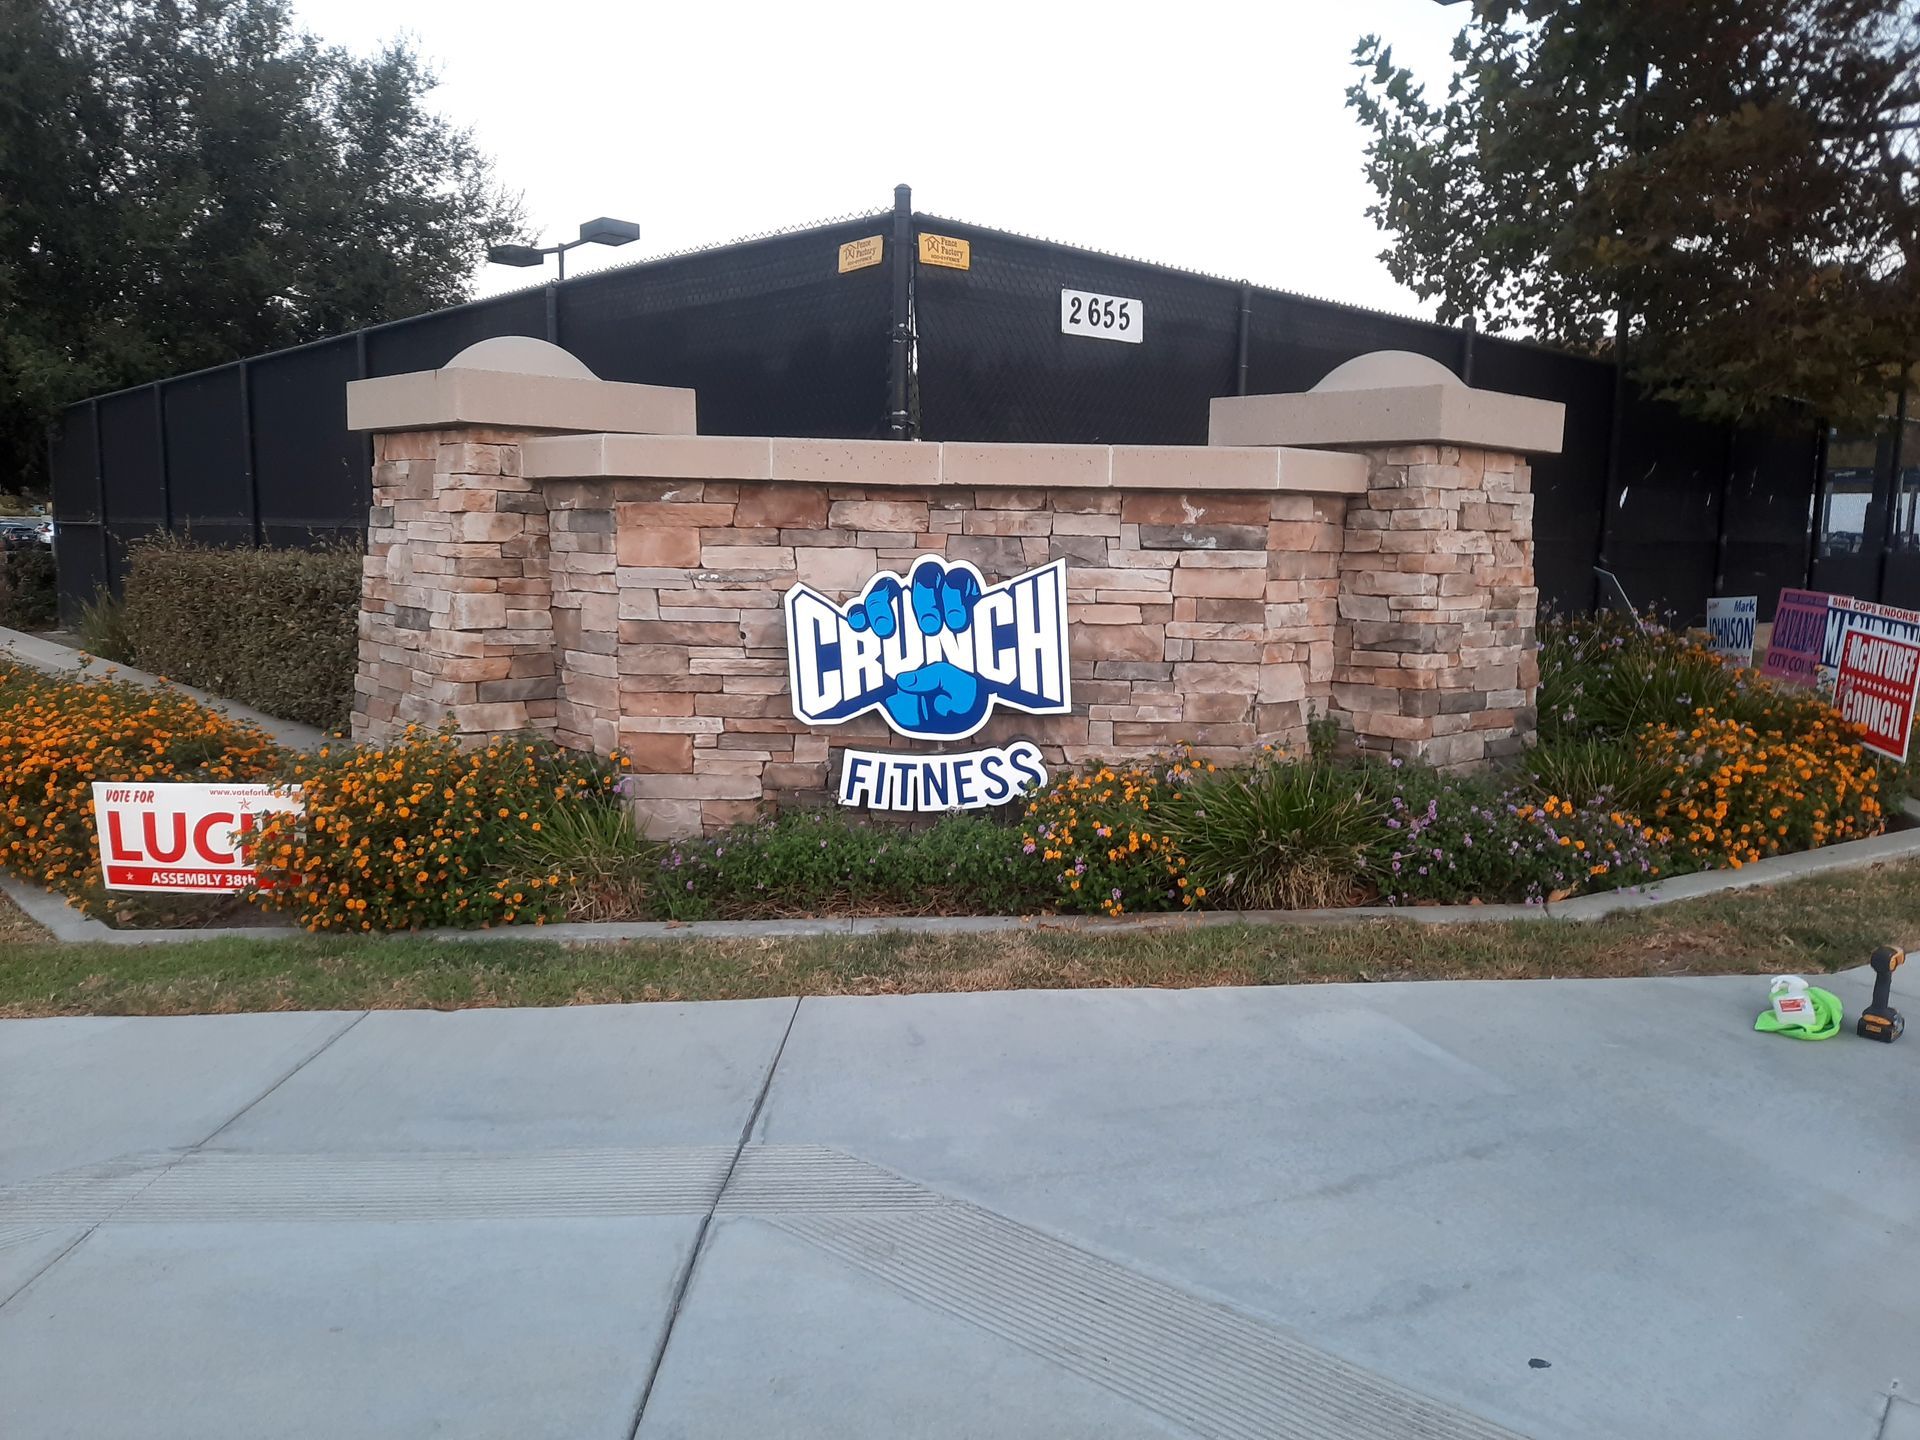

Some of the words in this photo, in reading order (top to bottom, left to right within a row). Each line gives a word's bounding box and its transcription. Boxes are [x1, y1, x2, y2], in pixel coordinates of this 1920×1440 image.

[941, 237, 958, 248] Fence
[941, 246, 964, 258] Factory
[1069, 296, 1130, 331] 2655
[1733, 600, 1756, 613] Mark
[1832, 597, 1852, 610] SIMI
[1853, 601, 1877, 615] COPS
[1708, 617, 1755, 650] JOHNSON
[794, 570, 1062, 718] CRUNCH
[1768, 652, 1788, 669] CITY
[1847, 634, 1919, 686] McINTURFF
[1842, 688, 1903, 741] COUNCIL
[846, 748, 1042, 803] FITNESS
[106, 789, 130, 802] VOTE
[133, 790, 154, 803] FOR
[151, 872, 222, 885] ASSEMBLY
[225, 875, 257, 886] 38th
